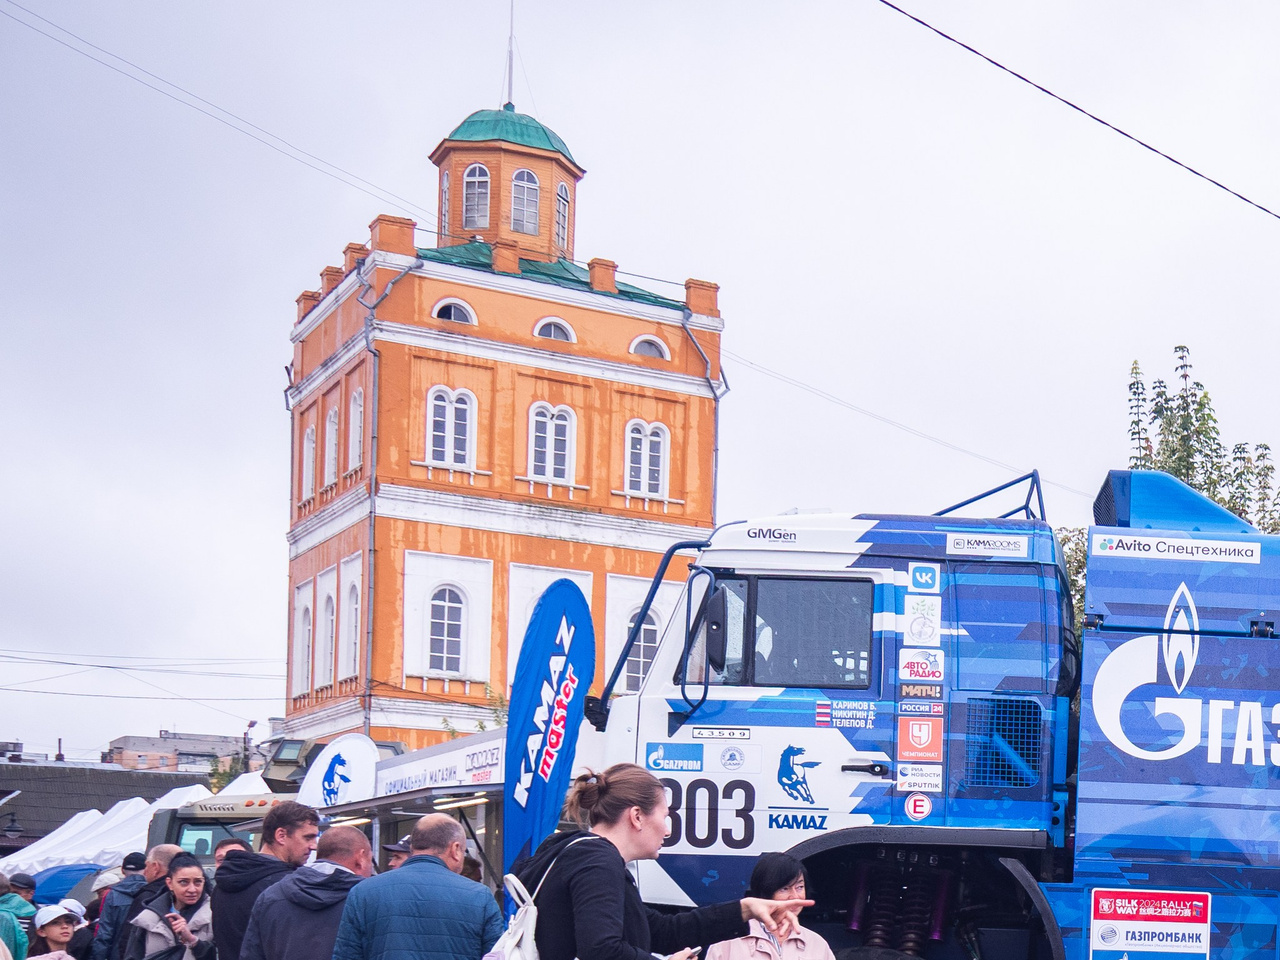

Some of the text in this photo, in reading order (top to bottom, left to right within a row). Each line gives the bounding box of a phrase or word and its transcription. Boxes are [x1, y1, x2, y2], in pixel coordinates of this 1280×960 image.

[747, 528, 797, 541] GMGen
[967, 539, 1021, 549] KAMAROOMS
[1115, 539, 1254, 557] Avito Спецтехника
[902, 661, 928, 670] АВТО
[909, 670, 942, 678] РАДИО
[902, 684, 941, 698] МАТЧ!
[513, 614, 576, 809] KAMAZ
[832, 701, 877, 711] КАРИМОВ Б.
[901, 704, 942, 713] РОССИЯ 24
[832, 710, 867, 719] НИКИТИН
[538, 663, 579, 783] master
[832, 719, 866, 728] ТЕЛЕПОВ
[465, 747, 500, 772] KAMAZ
[663, 759, 701, 771] GAZPROM
[429, 765, 458, 785] МАГАЗИН
[768, 813, 828, 830] KAMAZ
[1115, 898, 1191, 909] SILK 2024 RALLY
[1116, 906, 1138, 915] WAY
[1125, 930, 1202, 943] ГАЗПРОМБАНК
